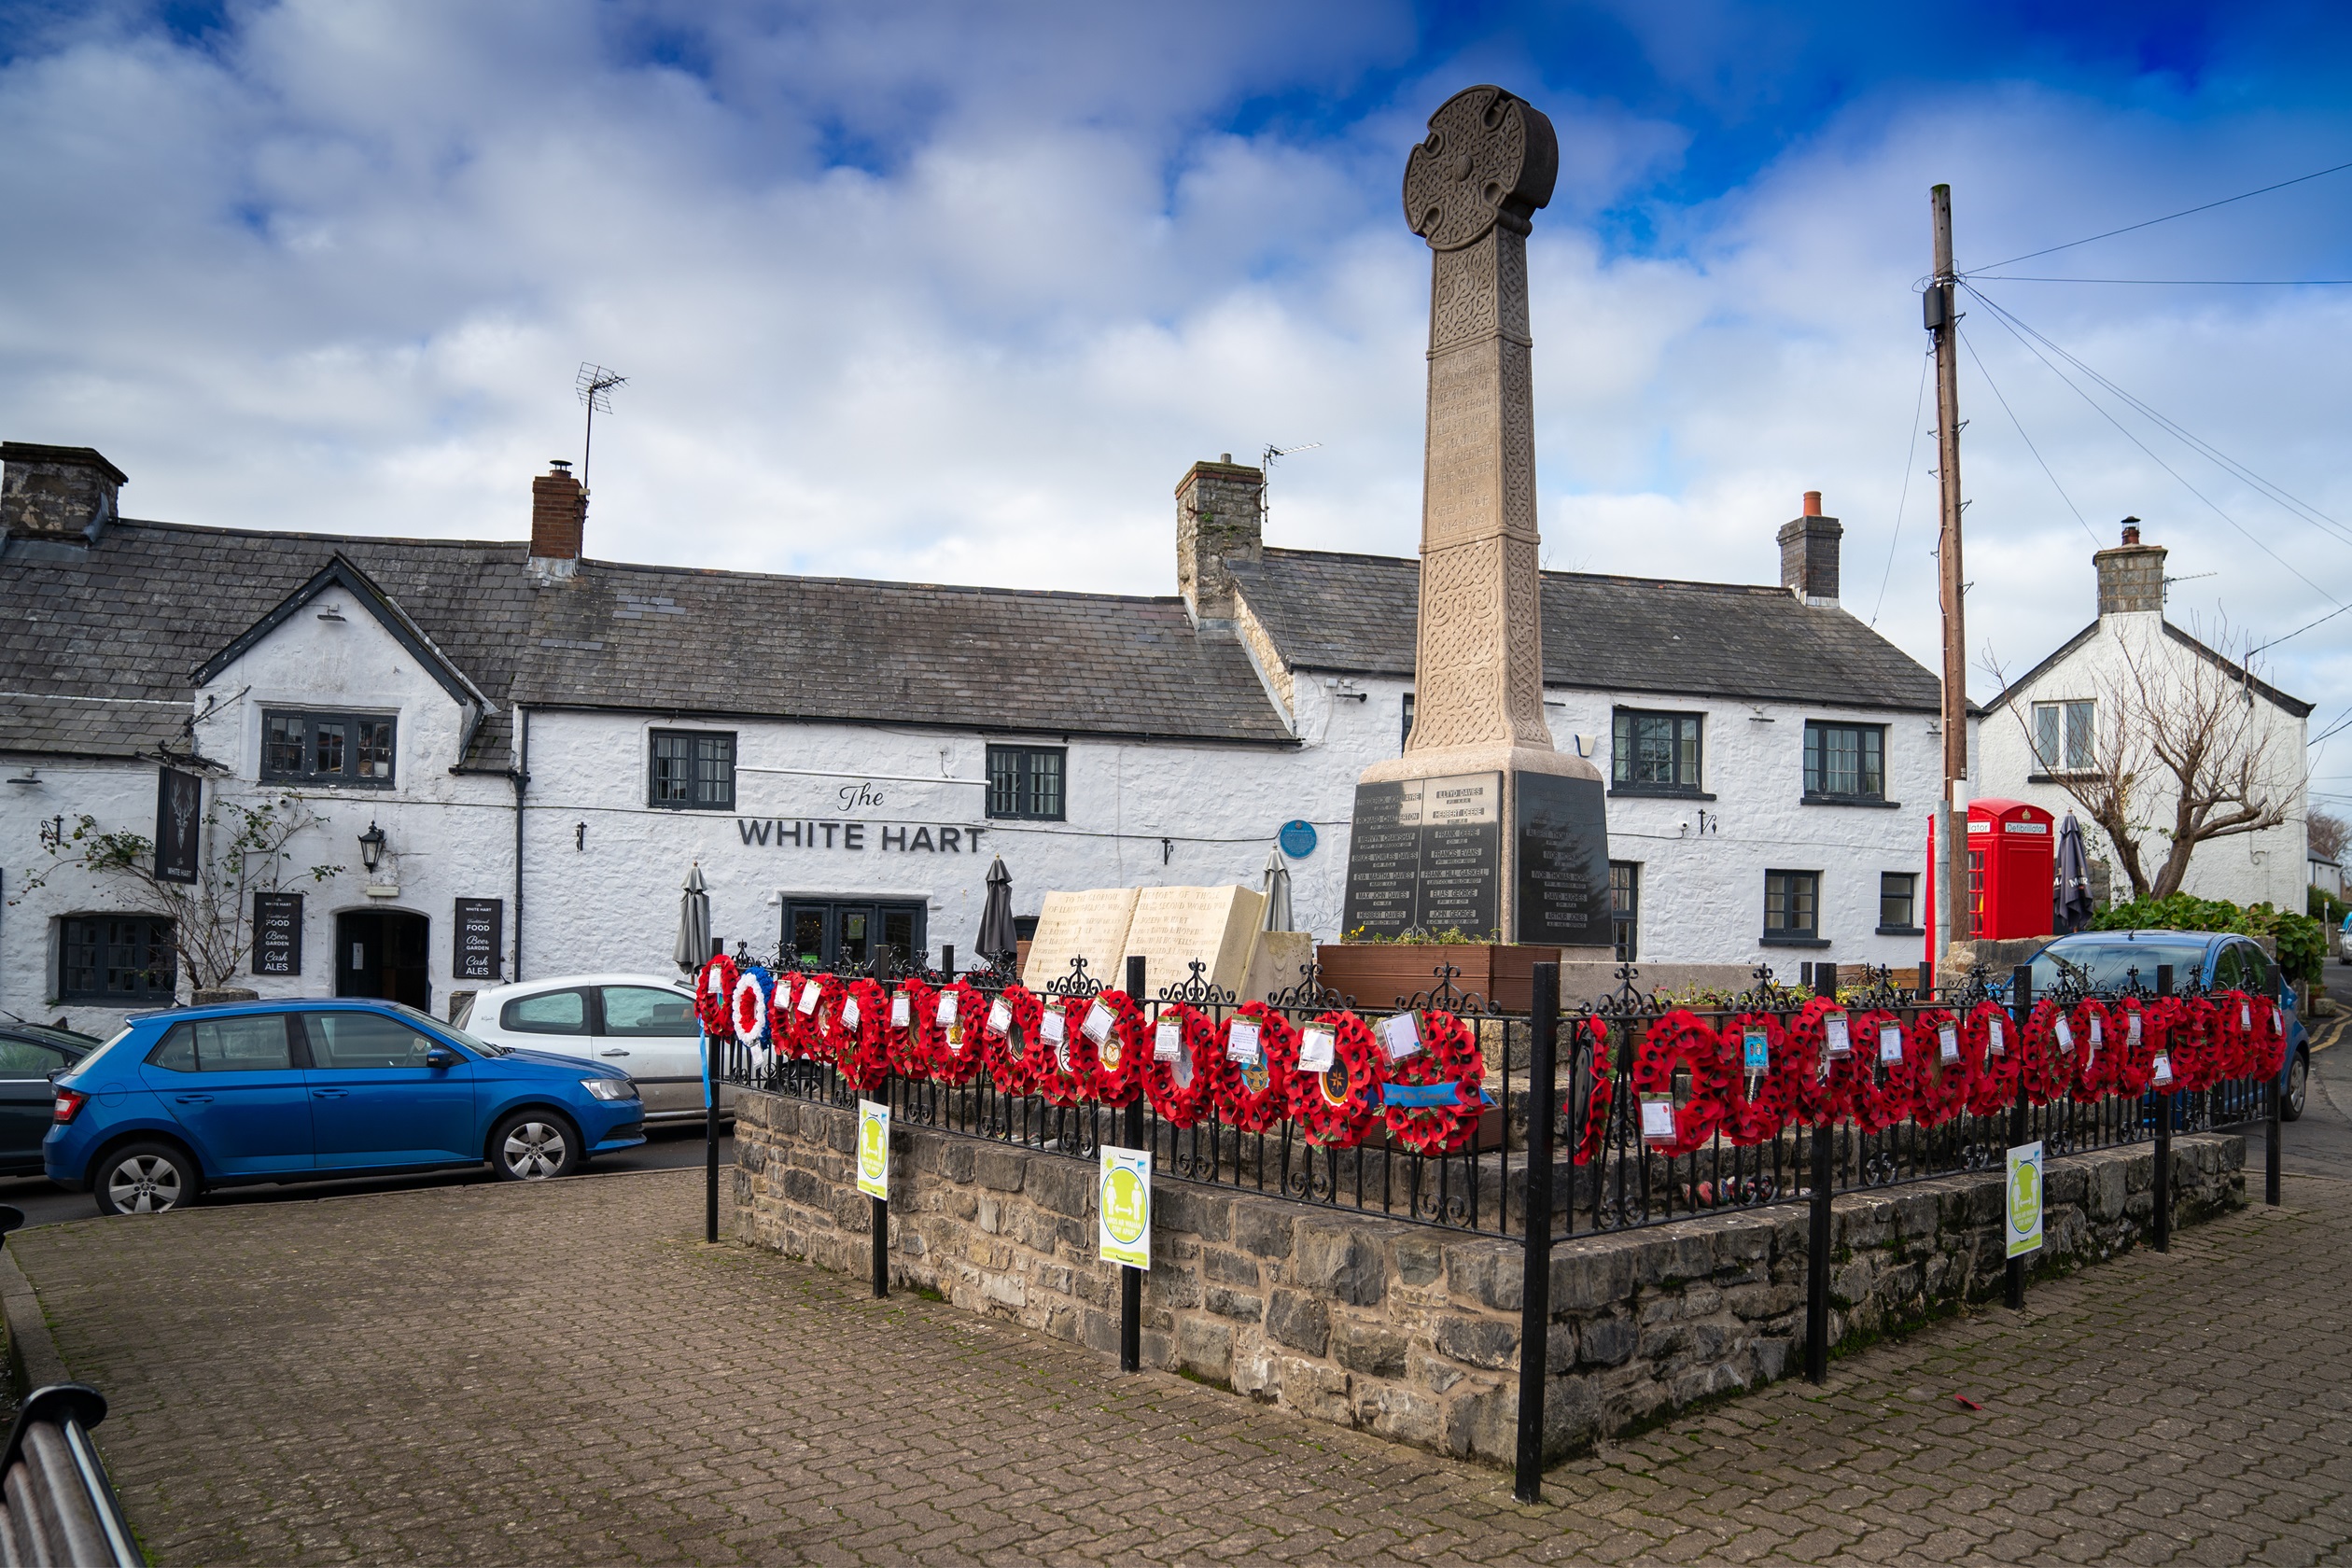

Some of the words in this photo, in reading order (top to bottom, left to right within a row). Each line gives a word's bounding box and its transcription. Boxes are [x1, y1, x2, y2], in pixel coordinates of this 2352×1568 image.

[1435, 404, 1463, 421] THOSE
[1430, 470, 1455, 487] THEIR
[1459, 482, 1477, 496] THE
[1434, 501, 1464, 518] GREAT
[1469, 495, 1491, 509] WAR
[837, 782, 884, 811] The
[1460, 788, 1480, 796] DAVIES
[1405, 793, 1420, 802] AYRE
[2007, 823, 2045, 833] Defibrillator
[737, 819, 864, 850] WHITE
[882, 826, 986, 853] HART
[1437, 830, 1457, 838] FRANK
[1354, 853, 1371, 861] BRUCE
[1434, 849, 1457, 858] FRANCIS
[1460, 848, 1479, 857] EVANS
[167, 867, 180, 876] WHITE
[181, 869, 191, 877] HART
[1368, 872, 1390, 880] MARTHA
[1460, 868, 1487, 876] GASKELL
[1141, 890, 1174, 900] MEMORY
[1179, 890, 1191, 899] OF
[1196, 891, 1221, 900] THOSE
[1049, 905, 1058, 914] OF
[1159, 902, 1185, 911] SECOND
[1188, 902, 1212, 911] WORLD
[265, 931, 289, 941] Beer
[467, 935, 490, 945] Beer
[265, 950, 288, 962] Cask
[466, 955, 488, 966] Cask
[265, 963, 288, 972] ALES
[466, 967, 489, 975] ALES
[1159, 968, 1183, 977] OWEN
[1112, 1225, 1122, 1234] STAY
[1123, 1227, 1136, 1237] APART
